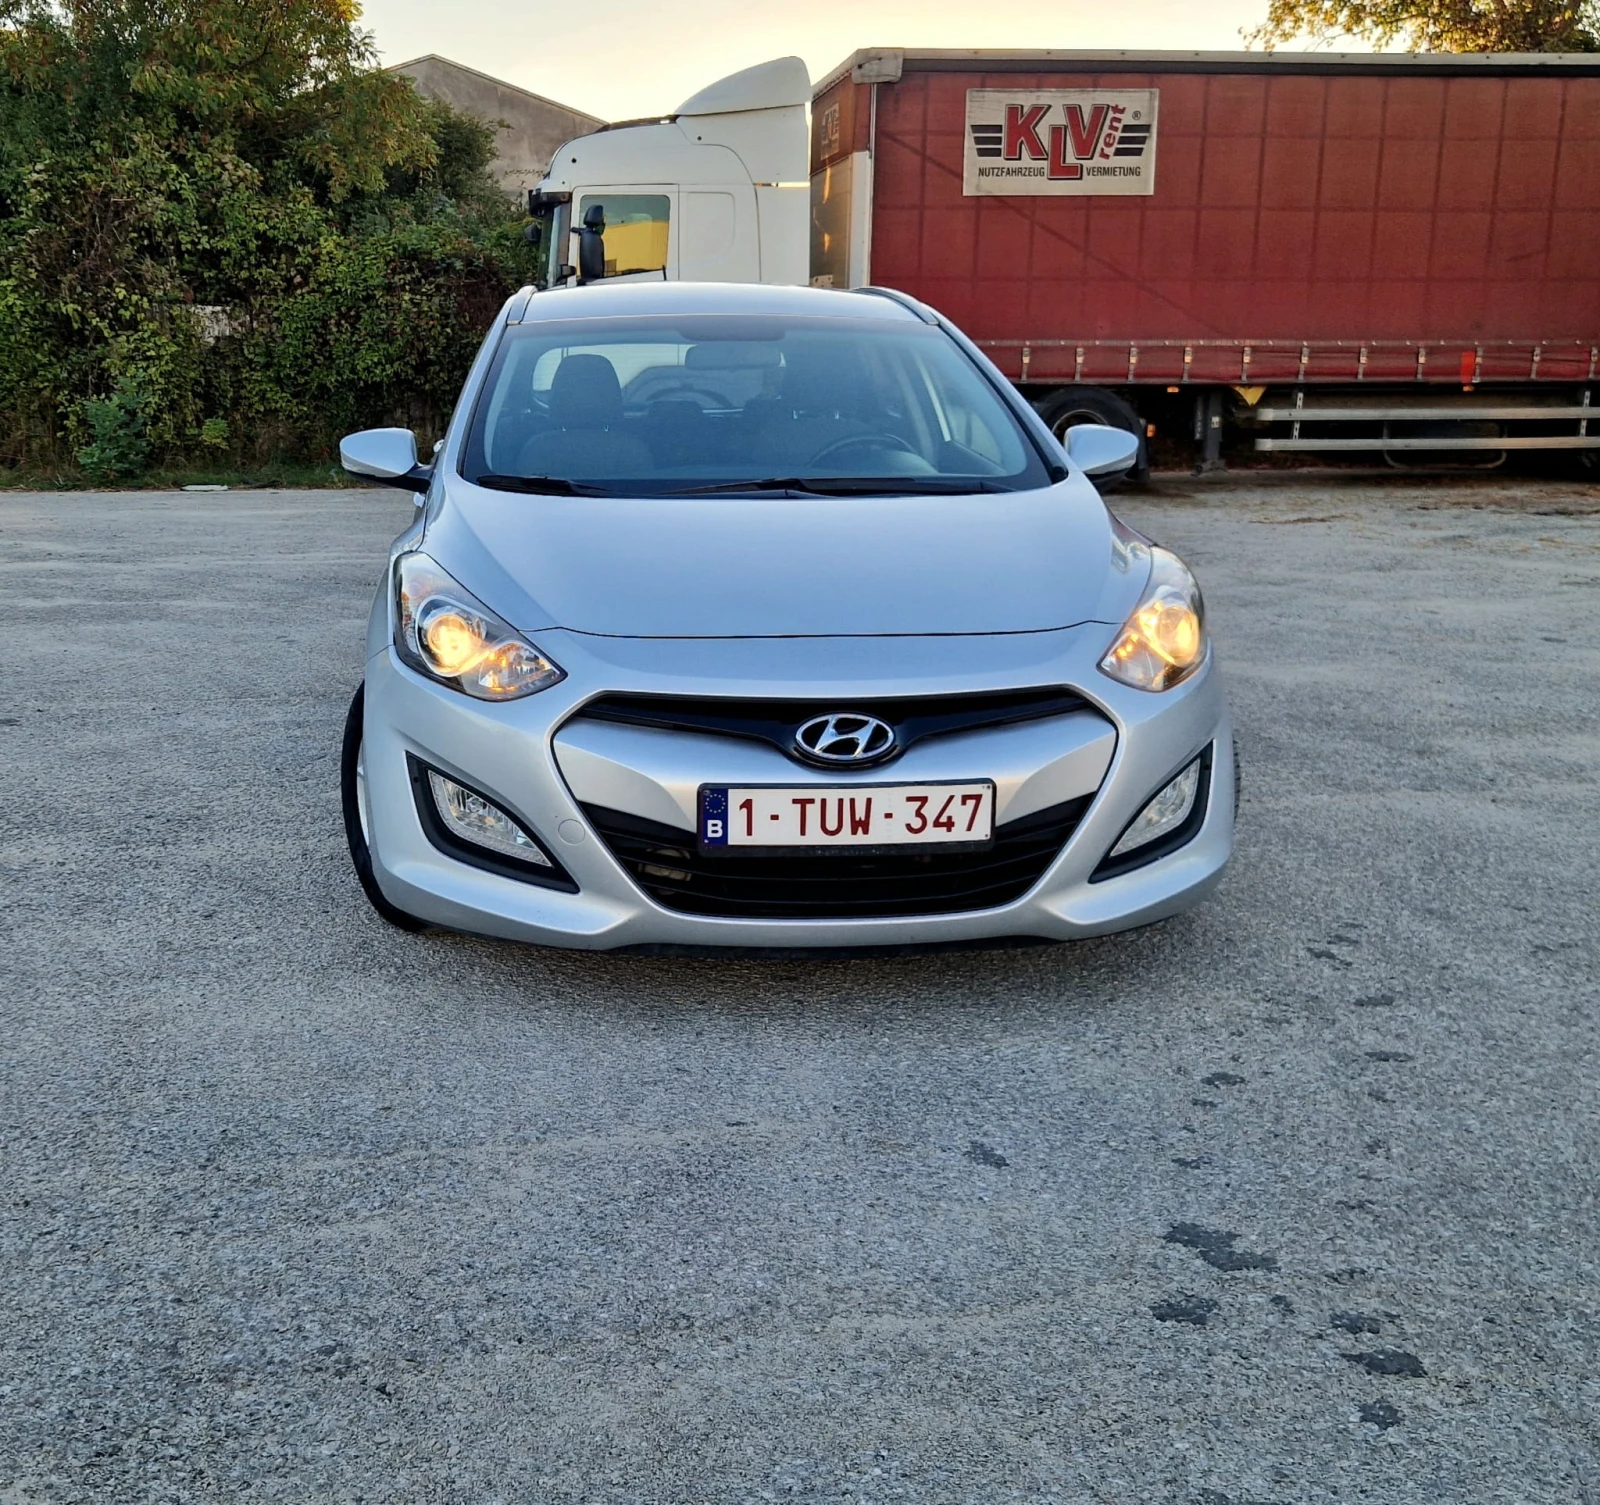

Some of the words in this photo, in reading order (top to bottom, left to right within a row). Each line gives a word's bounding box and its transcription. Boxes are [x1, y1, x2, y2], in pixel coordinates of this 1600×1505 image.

[1003, 104, 1110, 180] KLV
[1099, 104, 1126, 160] rent
[978, 166, 1045, 178] NUTZFAHRZEUG
[1086, 166, 1141, 177] VERMIETUNG
[707, 819, 724, 838] B
